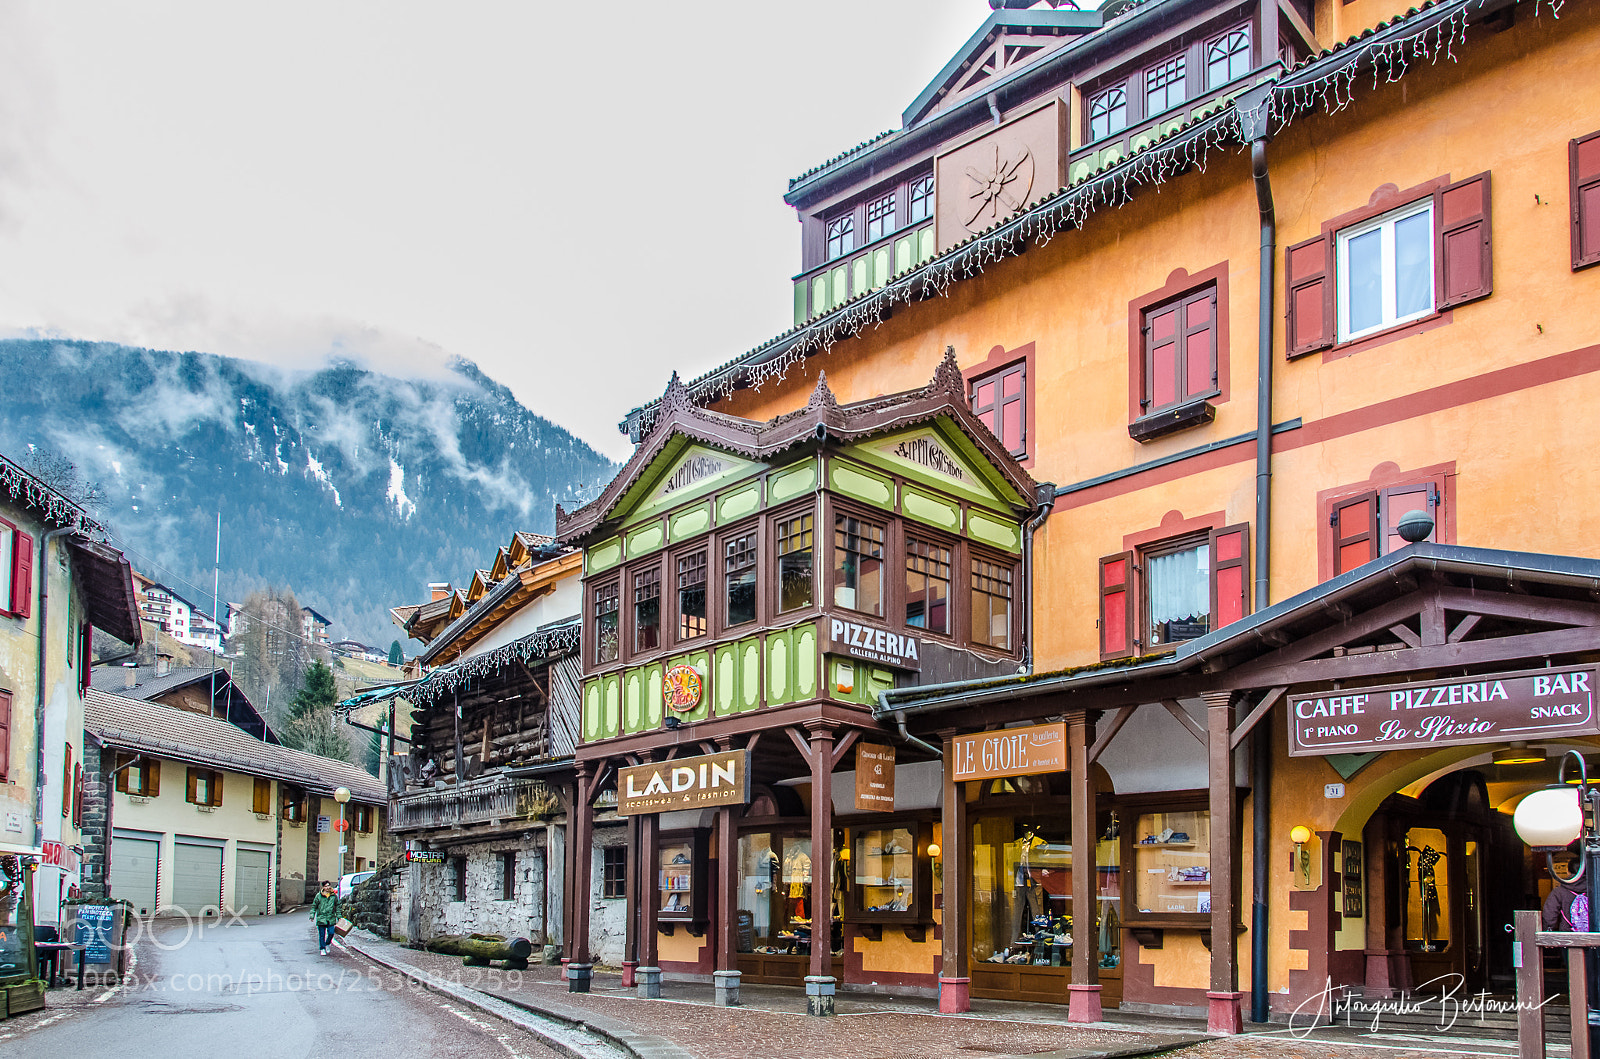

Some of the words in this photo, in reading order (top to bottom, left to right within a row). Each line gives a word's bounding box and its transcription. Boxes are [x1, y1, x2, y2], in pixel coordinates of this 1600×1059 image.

[831, 619, 918, 661] PIZZERIA
[850, 647, 878, 660] GALLERIA
[880, 655, 901, 665] ALPINO
[1295, 693, 1370, 719] CAFFE'
[1390, 680, 1509, 711] PIZZERIA
[1533, 671, 1591, 697] BAR
[1317, 724, 1359, 737] PIANO
[1374, 718, 1411, 742] Lo
[1414, 716, 1497, 742] Sfizio
[1530, 703, 1582, 719] SNACK
[956, 741, 976, 775] LE
[626, 760, 736, 798] LADIN
[683, 793, 690, 802] &
[697, 789, 736, 801] fashion
[1330, 788, 1339, 796] 31
[410, 850, 445, 859] MOSTRA
